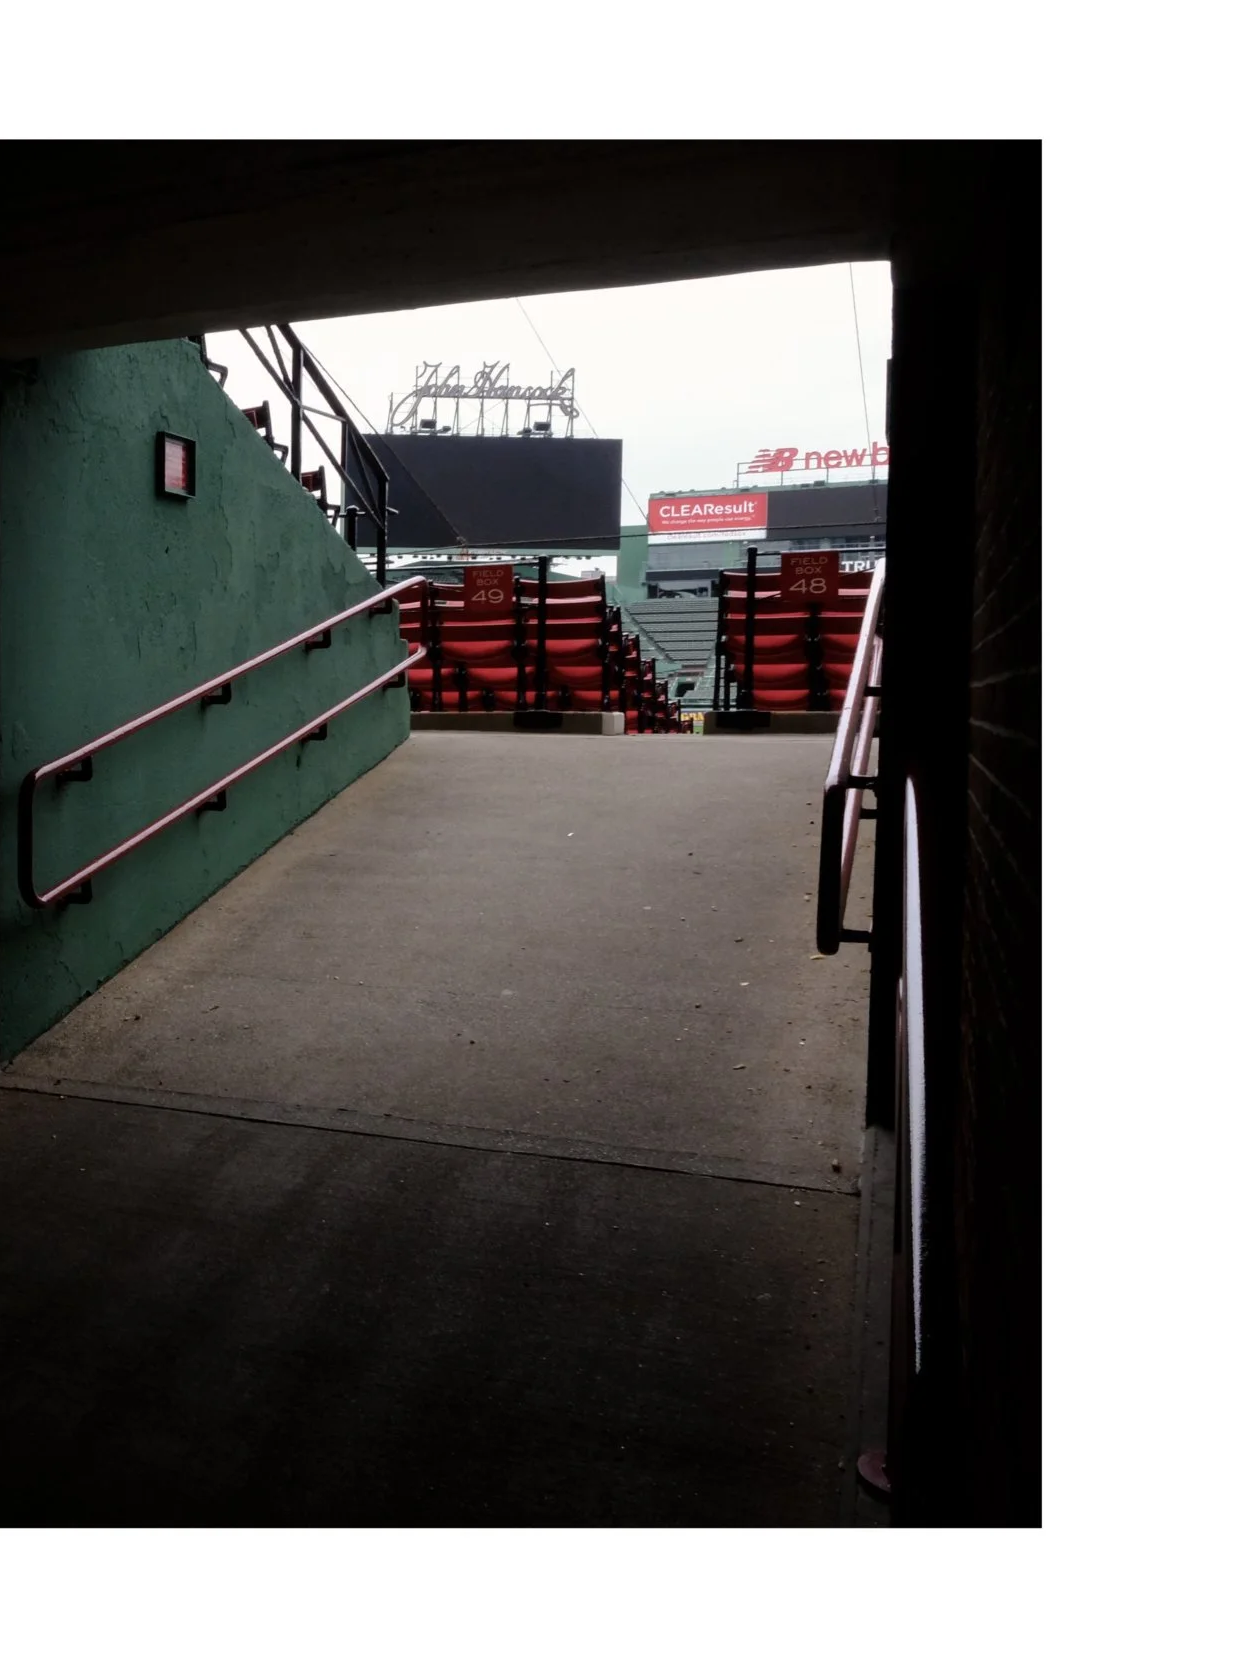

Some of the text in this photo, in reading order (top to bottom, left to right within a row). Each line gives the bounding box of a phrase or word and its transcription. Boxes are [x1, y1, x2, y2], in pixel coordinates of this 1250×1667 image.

[390, 361, 580, 427] John Hancock
[805, 448, 867, 469] new
[659, 500, 755, 518] CLEAResult
[790, 556, 828, 566] FIELD
[472, 569, 504, 578] FIELD
[795, 566, 822, 575] BOX
[476, 578, 499, 586] BOX
[789, 578, 827, 594] 48
[471, 588, 504, 604] 49
